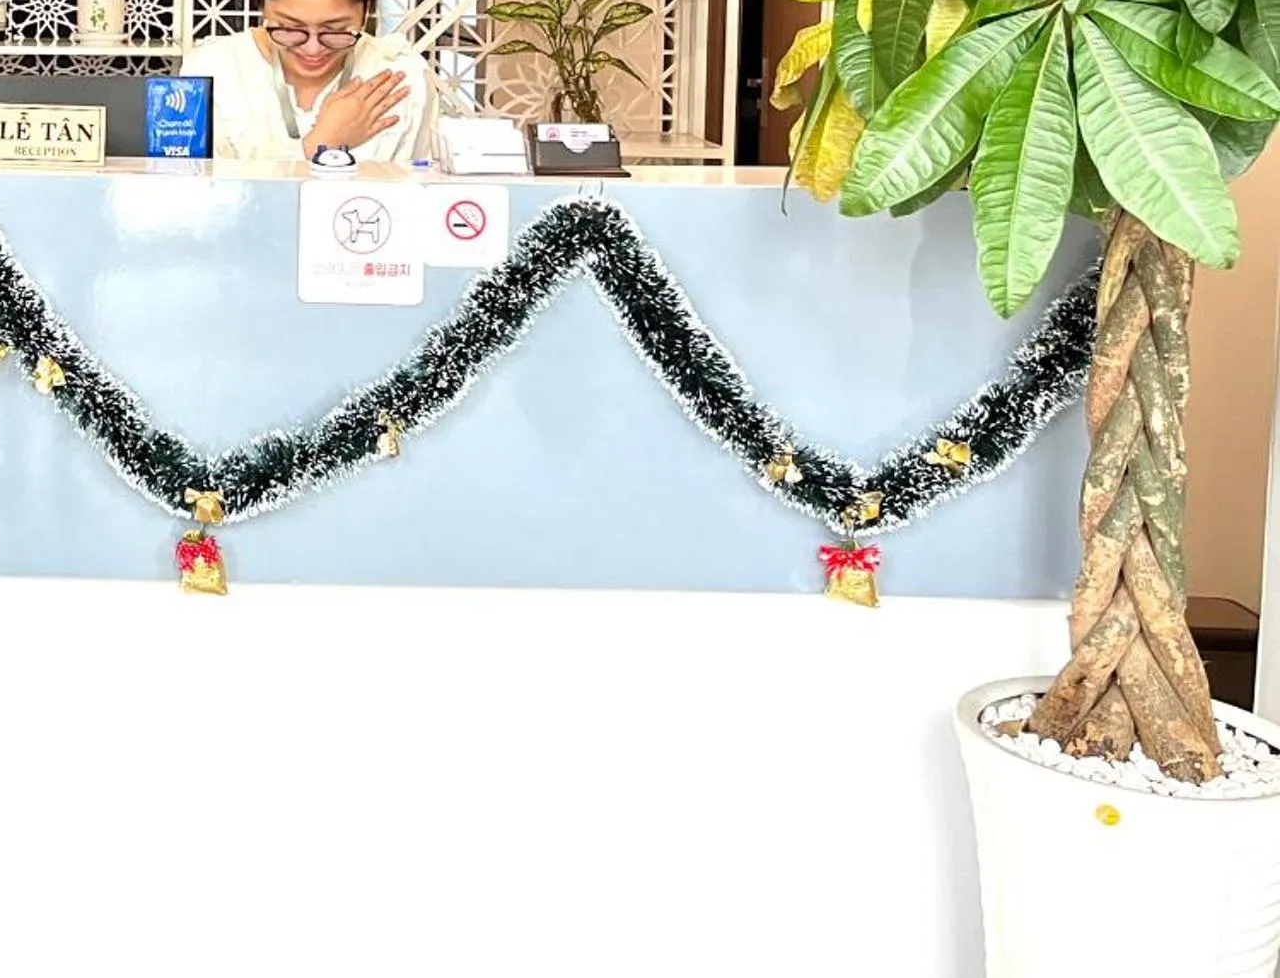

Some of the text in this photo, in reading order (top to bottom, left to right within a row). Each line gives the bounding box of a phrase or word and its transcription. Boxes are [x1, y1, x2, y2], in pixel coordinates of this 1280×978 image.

[0, 111, 95, 143] LỄ TÂN
[14, 145, 78, 157] RECEPTION
[162, 145, 190, 157] VISA
